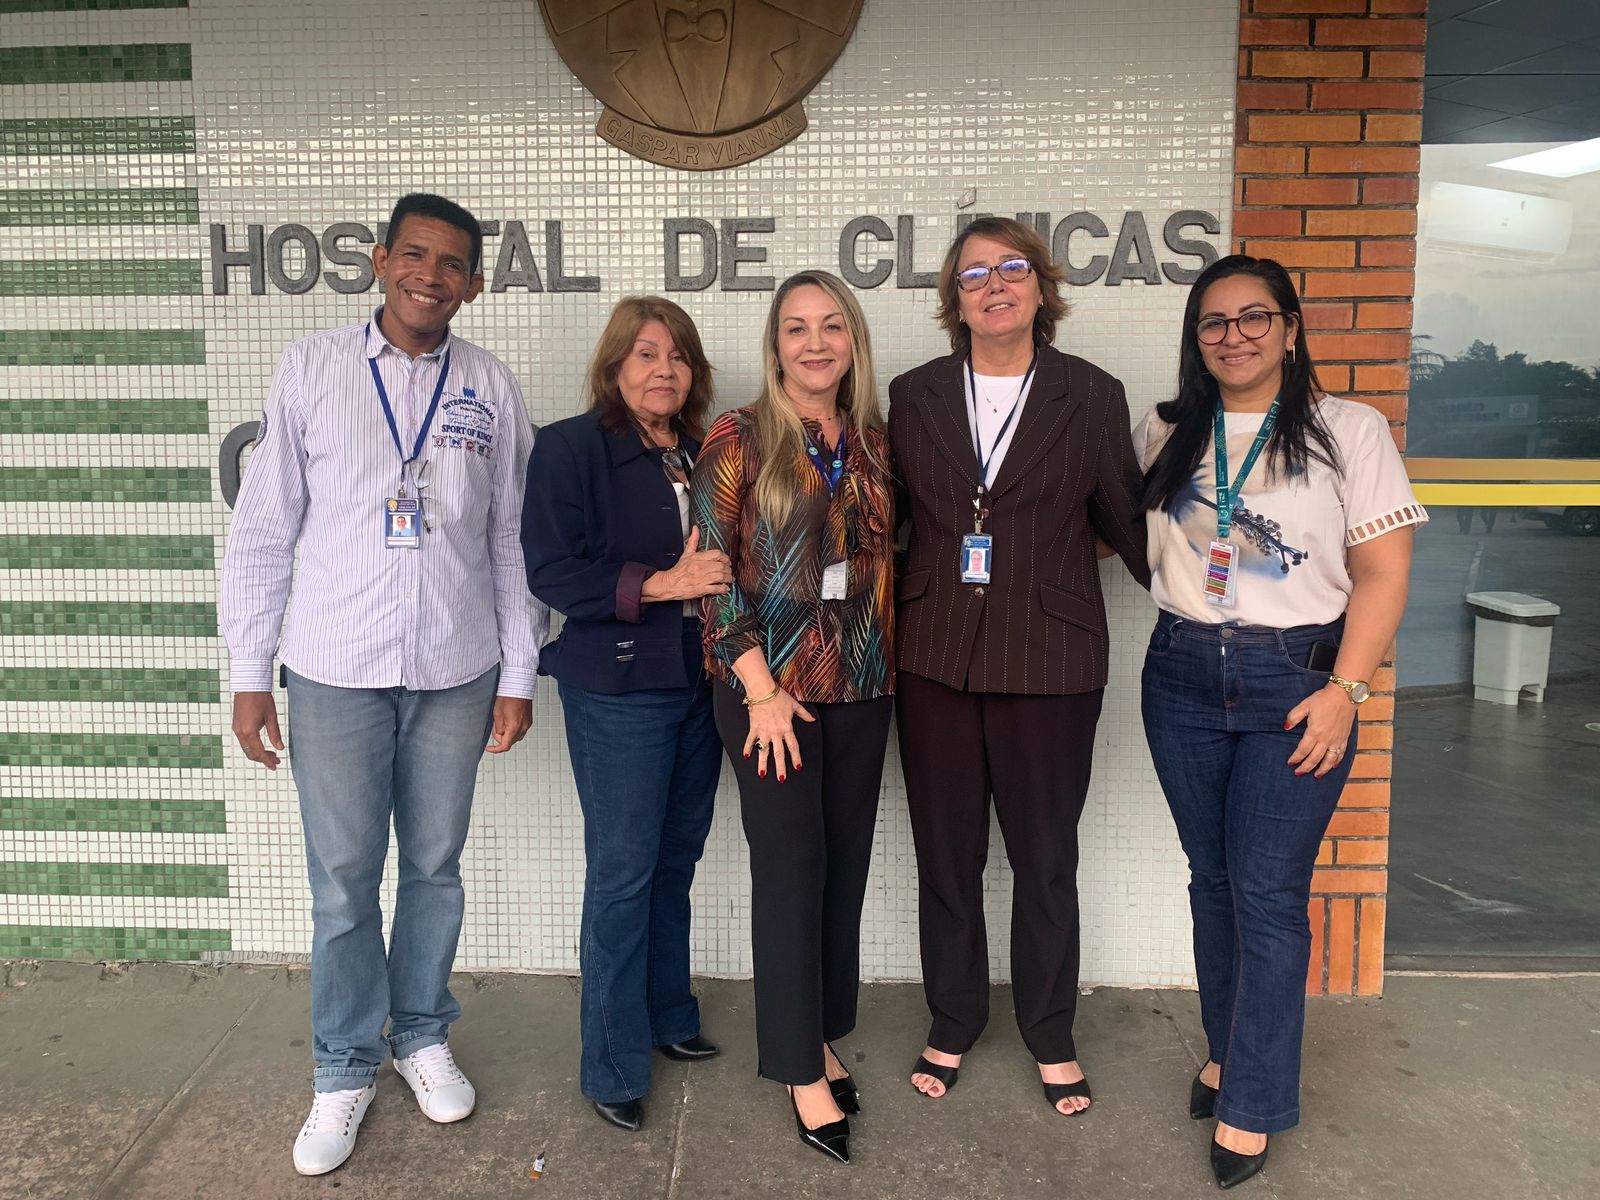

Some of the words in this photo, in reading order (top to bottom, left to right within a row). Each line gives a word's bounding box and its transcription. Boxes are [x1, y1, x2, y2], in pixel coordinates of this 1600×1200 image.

[603, 113, 699, 165] GASPAR
[706, 111, 801, 165] VIANNA
[210, 219, 600, 295] HOSAL
[663, 217, 776, 293] DE
[838, 188, 1221, 290] CLCAS
[441, 399, 495, 422] INTERNATIONAL
[441, 425, 466, 435] SPORT
[467, 428, 476, 437] OF
